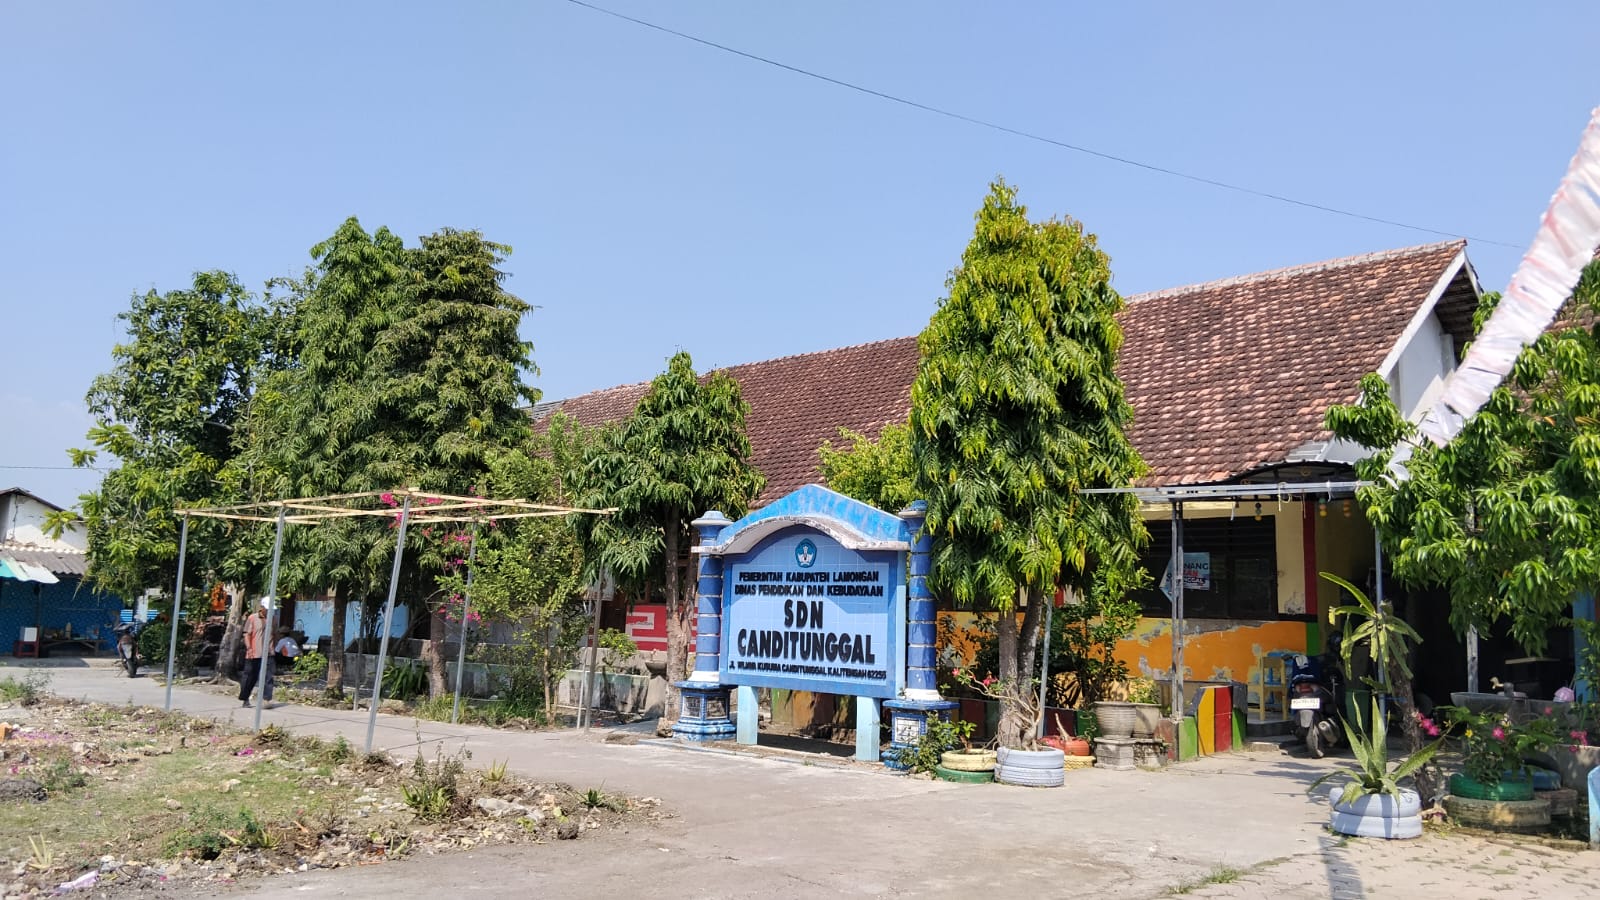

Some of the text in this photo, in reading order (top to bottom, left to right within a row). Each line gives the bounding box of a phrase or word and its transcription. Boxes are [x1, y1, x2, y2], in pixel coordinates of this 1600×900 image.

[739, 571, 879, 583] PEMERINTAH KABUPATEN LAMONGAN
[735, 584, 883, 596] DINAS PENDIDIKAN DAN KEBUDAYAAN
[784, 599, 823, 629] SDN
[737, 629, 875, 664] CANDITUNGGAL
[781, 664, 827, 676] CANDITUNGGAL
[827, 667, 867, 679] KALITENGAH
